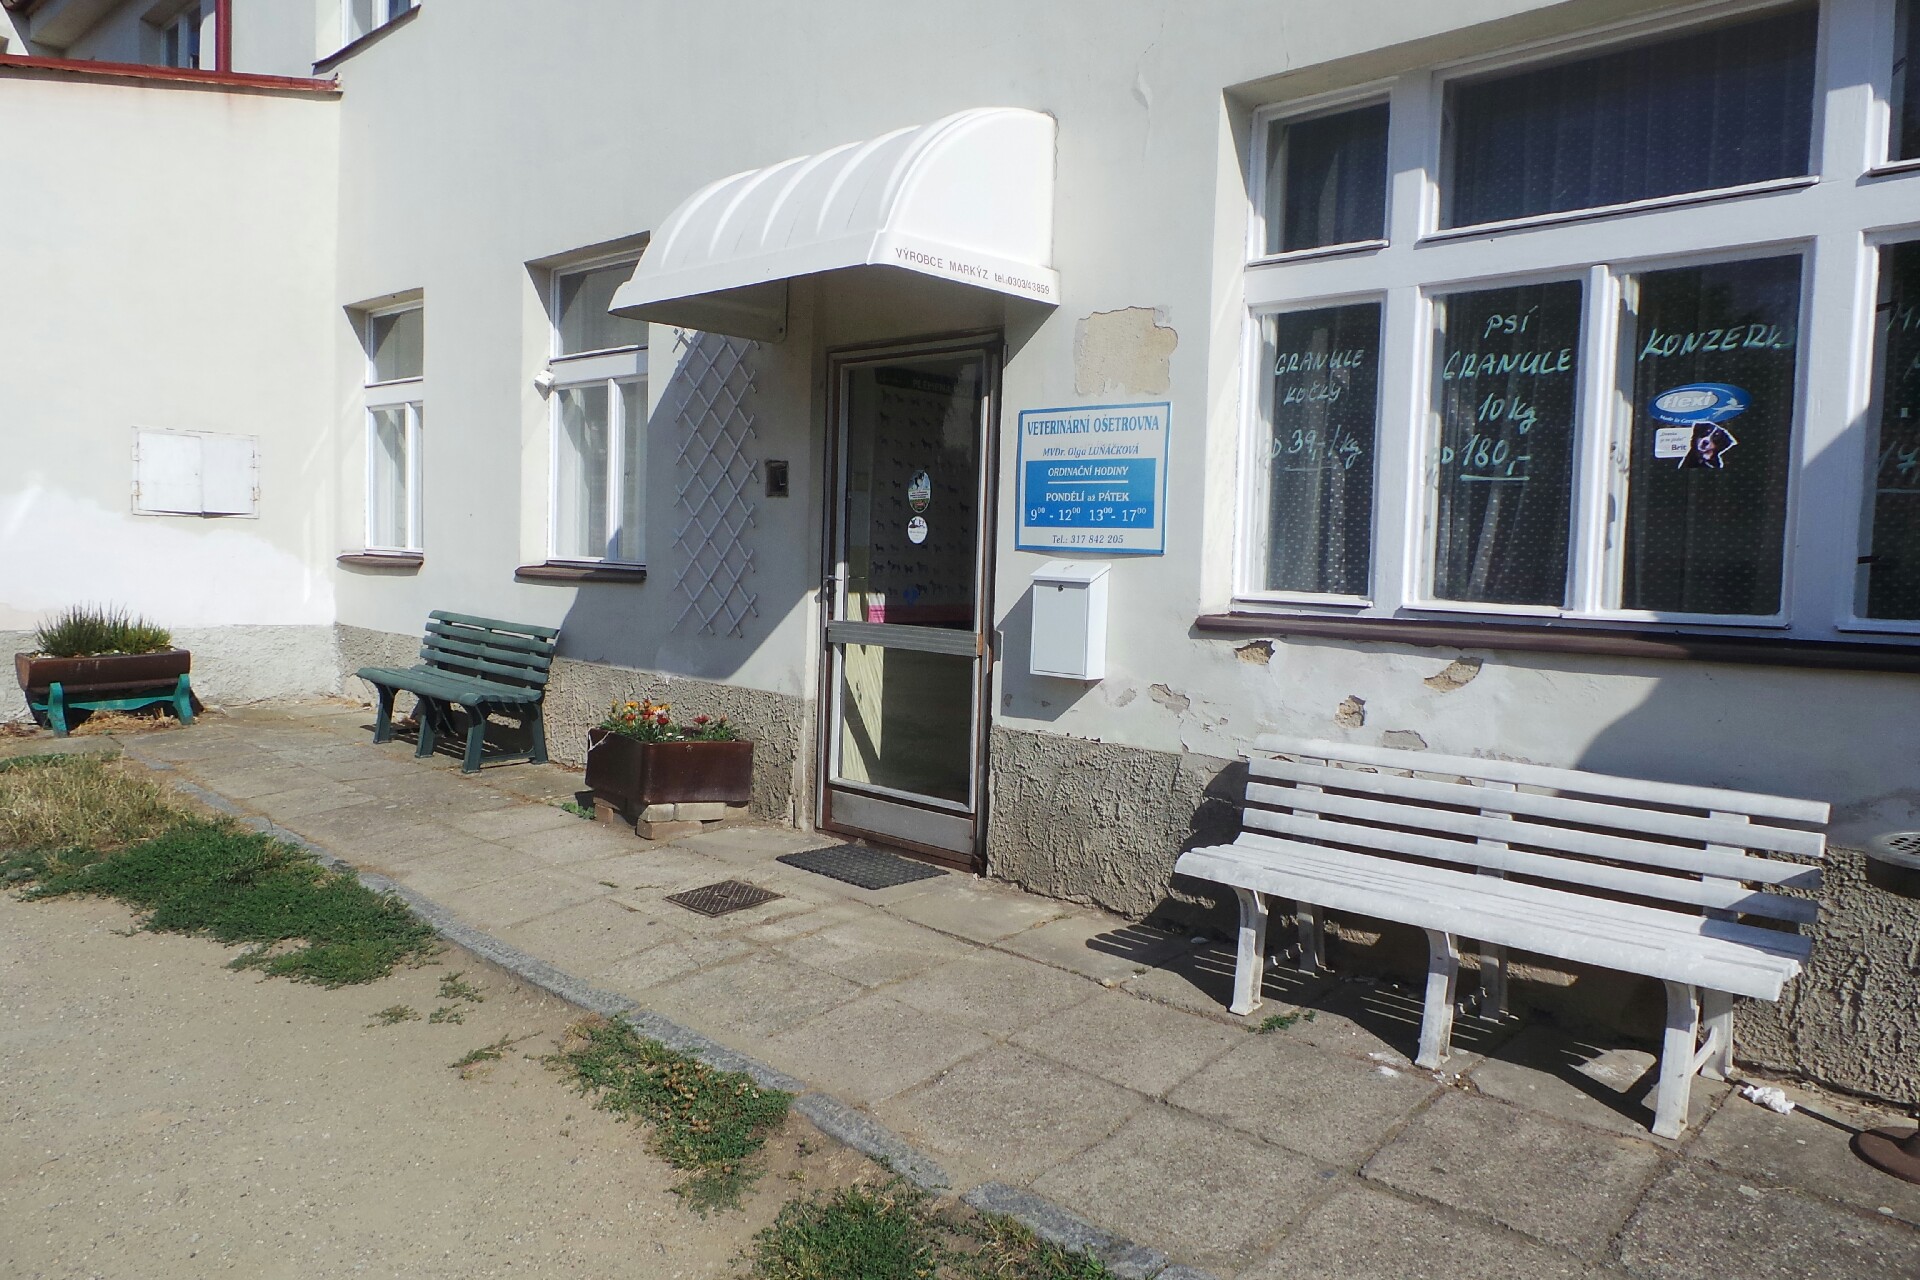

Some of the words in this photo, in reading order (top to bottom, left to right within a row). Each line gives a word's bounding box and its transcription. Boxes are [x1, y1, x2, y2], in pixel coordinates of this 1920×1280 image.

[895, 247, 943, 269] VÝROBCE
[949, 260, 988, 280] MARKÝZ
[1483, 305, 1539, 338] PSÍ
[1275, 348, 1365, 376] GRANULE
[1443, 348, 1572, 380] GRANULE
[1478, 393, 1504, 422] 10
[1663, 391, 1712, 408] flexi
[1027, 415, 1090, 436] VETERINÁRNÍ
[1094, 414, 1159, 433] OŠETROVNA
[1043, 447, 1066, 456] MVDr.
[1068, 447, 1086, 458] Olga
[1048, 465, 1093, 477] ORDINAČNÍ
[1094, 466, 1129, 476] HODINY
[1046, 490, 1085, 502] PONDĚLÍ
[1087, 494, 1096, 502] až
[1098, 490, 1129, 502] PÁTEK
[1052, 535, 1068, 544] Tel.:
[1070, 535, 1086, 544] 317
[1088, 535, 1104, 544] 842
[1107, 534, 1124, 544] 205
